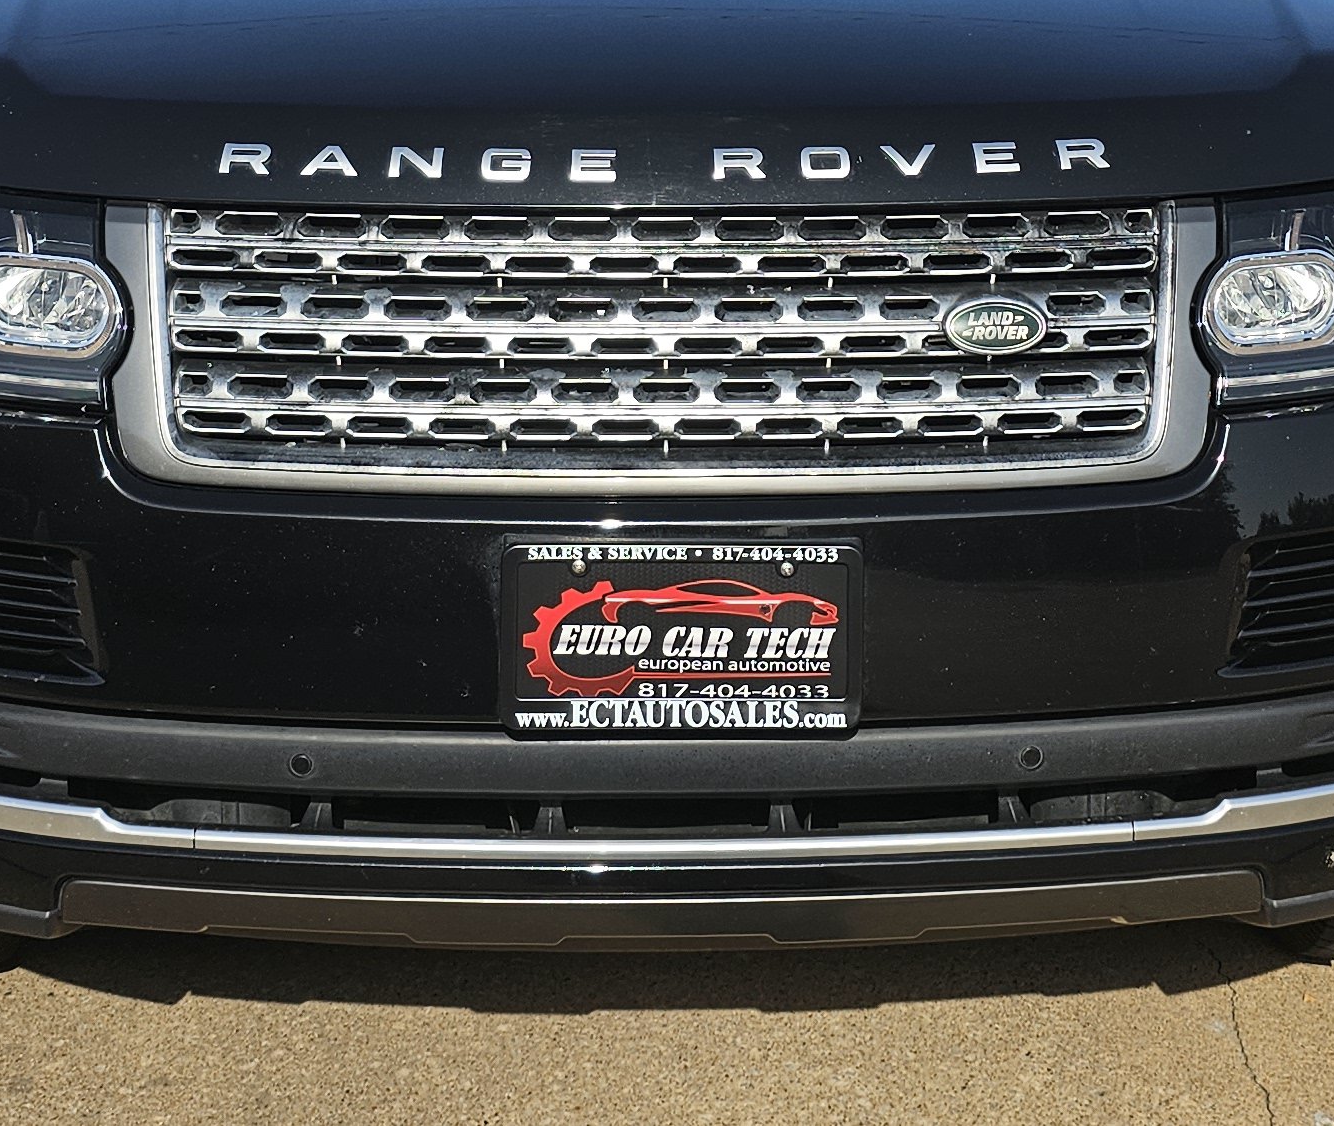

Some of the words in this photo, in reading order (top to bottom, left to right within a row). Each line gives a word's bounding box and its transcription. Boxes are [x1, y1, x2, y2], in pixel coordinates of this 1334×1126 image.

[218, 141, 617, 182] RANGE
[713, 137, 1111, 180] ROVER
[968, 311, 1014, 326] LAND
[971, 325, 1029, 341] ROVER
[527, 546, 584, 560] SALES
[587, 547, 603, 560] &
[607, 547, 688, 561] SERVICE
[712, 548, 839, 562] 817-404-4033
[553, 624, 652, 656] EURO
[662, 626, 734, 658] CAR
[745, 627, 837, 659] TECH
[638, 659, 724, 673] european
[728, 659, 831, 673] automotive
[638, 683, 830, 698] 817-404-4033
[515, 700, 847, 729] www.ECTAUTOSALES.com
